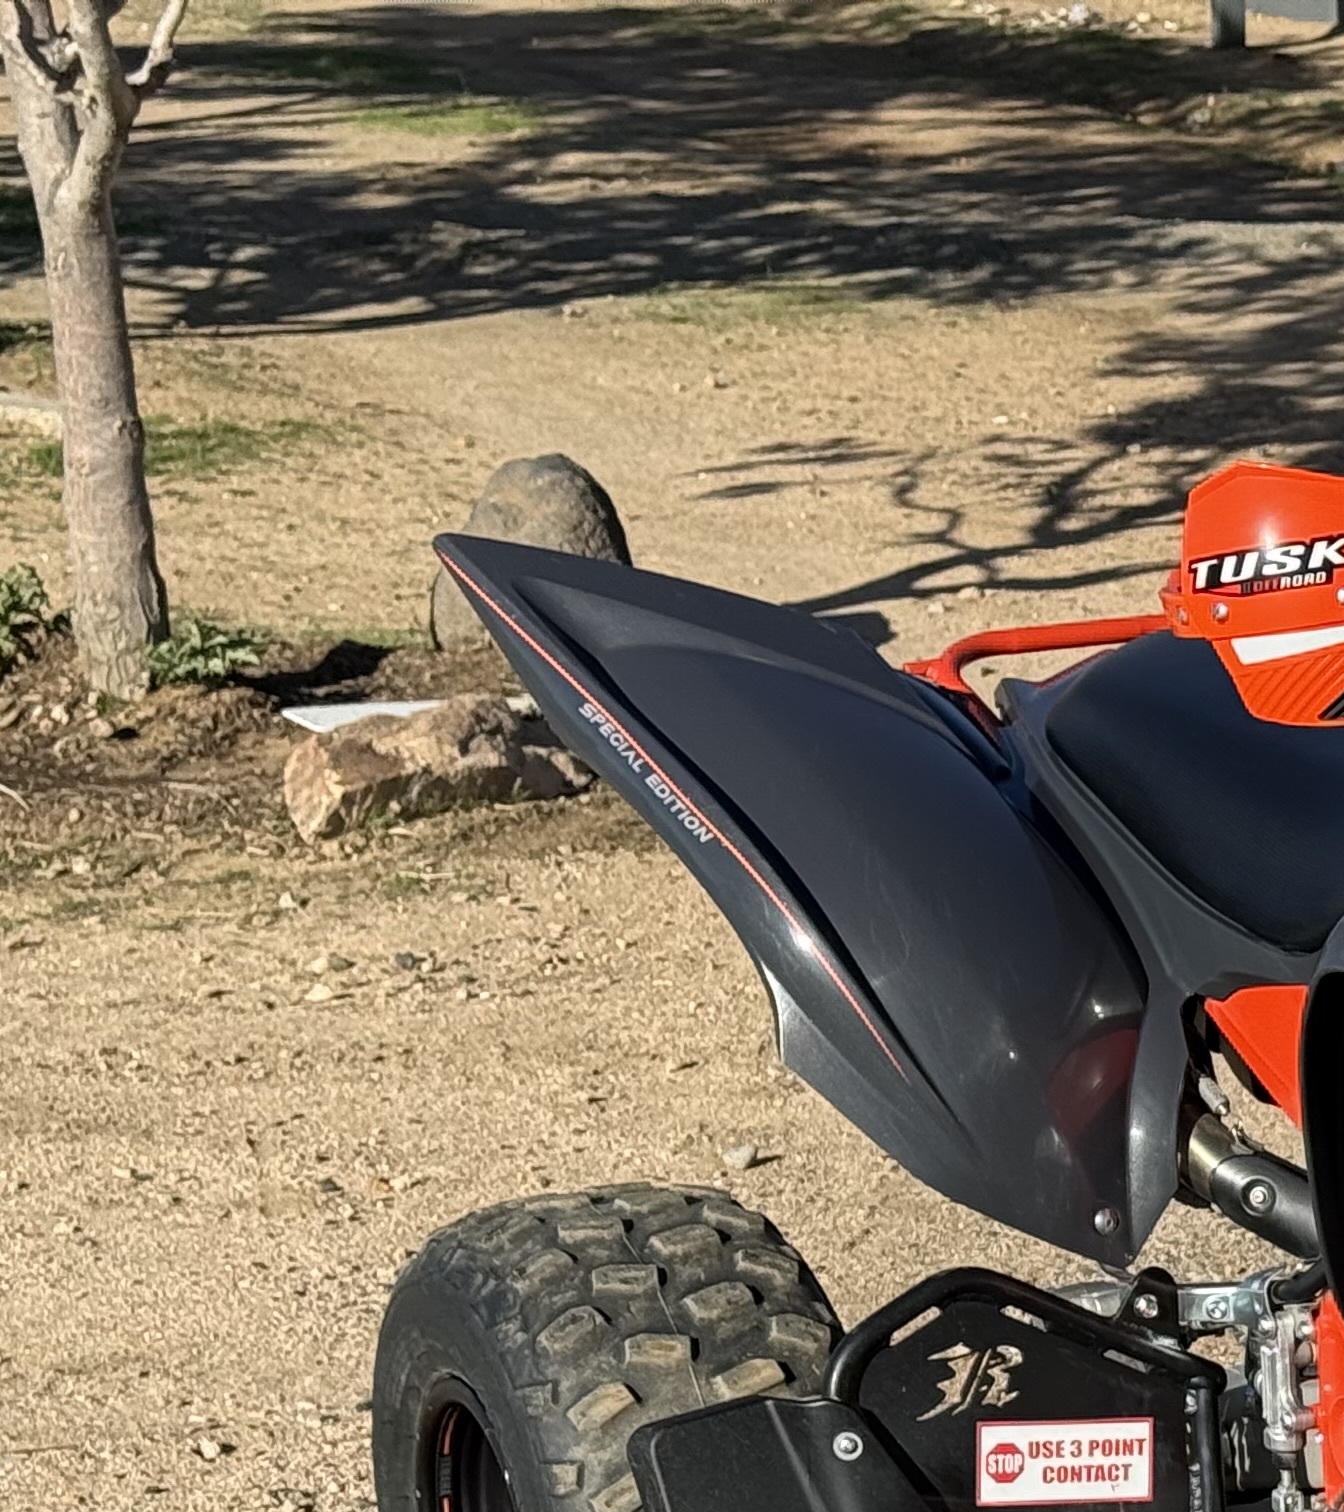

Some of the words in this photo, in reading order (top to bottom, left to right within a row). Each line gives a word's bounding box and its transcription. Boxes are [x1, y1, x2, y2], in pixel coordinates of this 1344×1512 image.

[578, 702, 643, 773] SPECIAL
[644, 773, 715, 844] EDITION
[1028, 1440, 1065, 1459] USE
[1070, 1440, 1080, 1458] 3
[1088, 1438, 1147, 1458] POINT
[987, 1453, 1024, 1474] STOP
[1042, 1464, 1133, 1484] CONTACT
